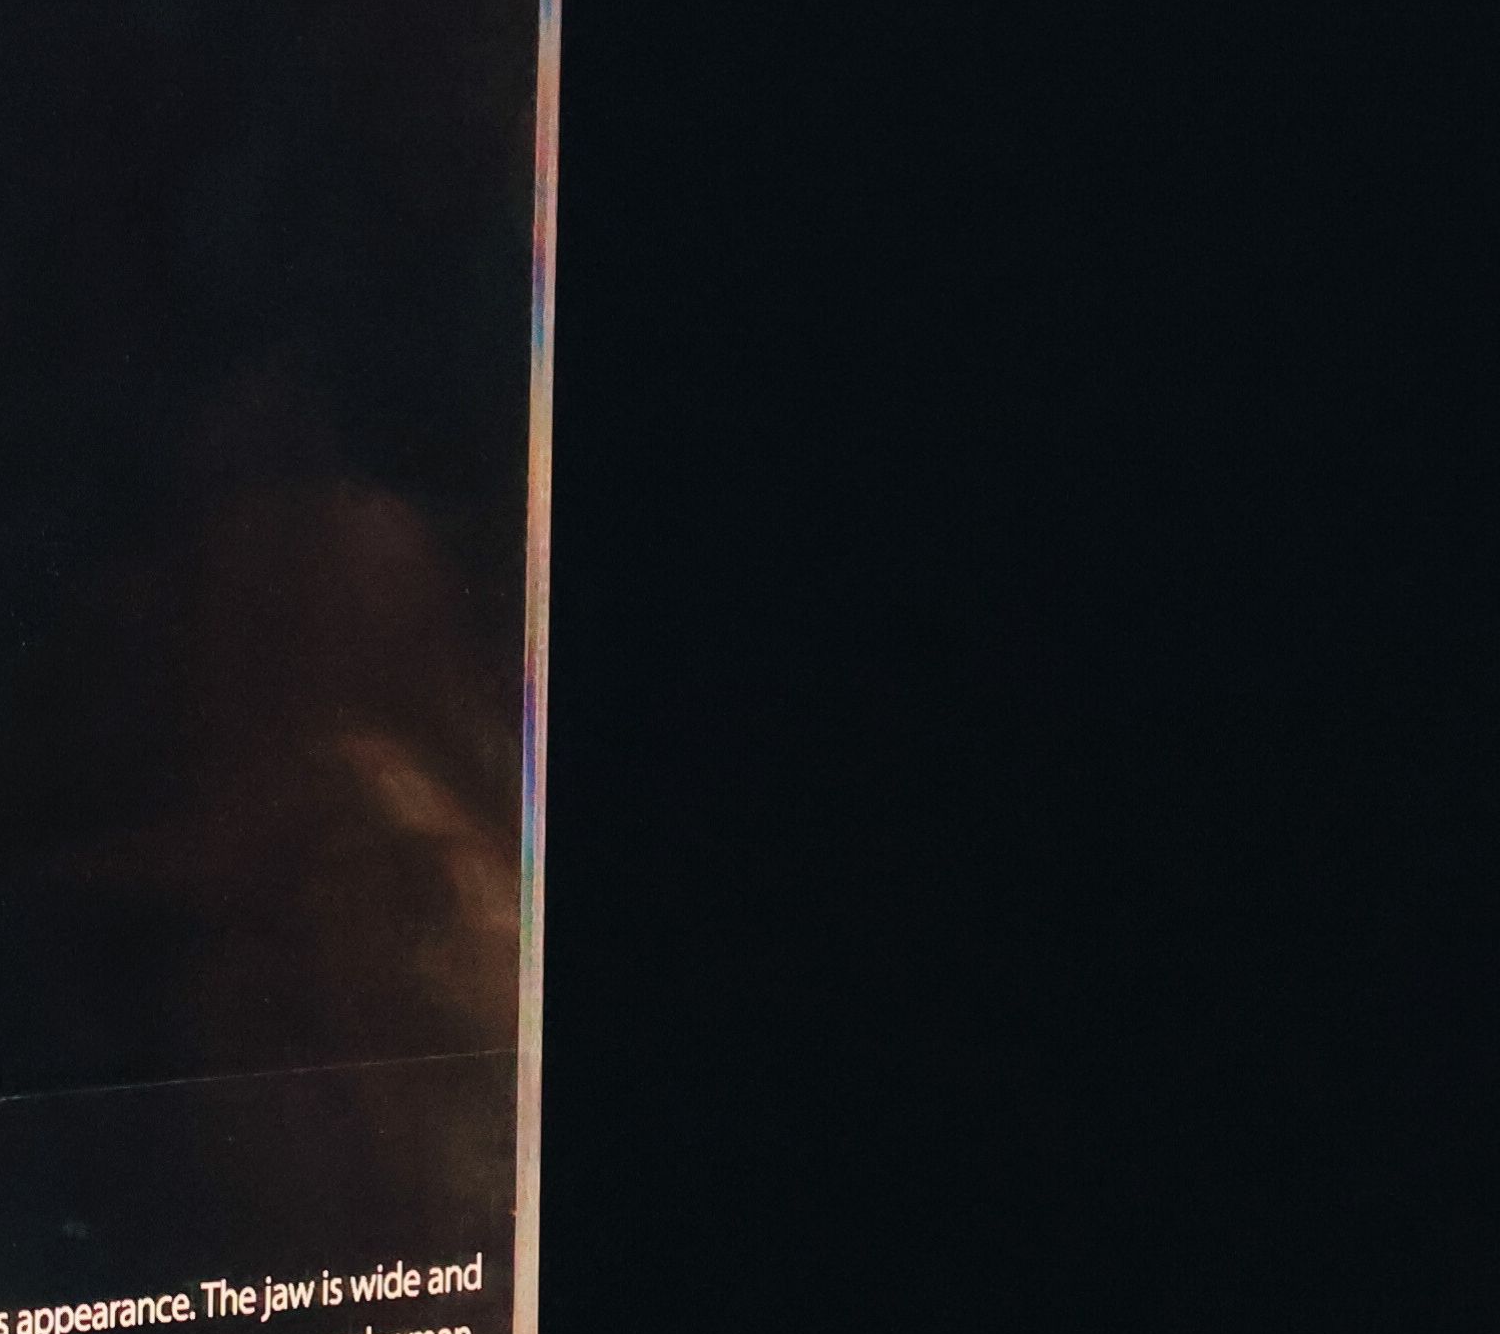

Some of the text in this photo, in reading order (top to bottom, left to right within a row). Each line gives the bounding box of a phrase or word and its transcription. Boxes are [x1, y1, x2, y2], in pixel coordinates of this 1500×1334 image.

[200, 1278, 256, 1317] The
[260, 1275, 314, 1322] jaw
[322, 1269, 342, 1305] is
[350, 1259, 421, 1302] wide
[427, 1251, 481, 1294] and
